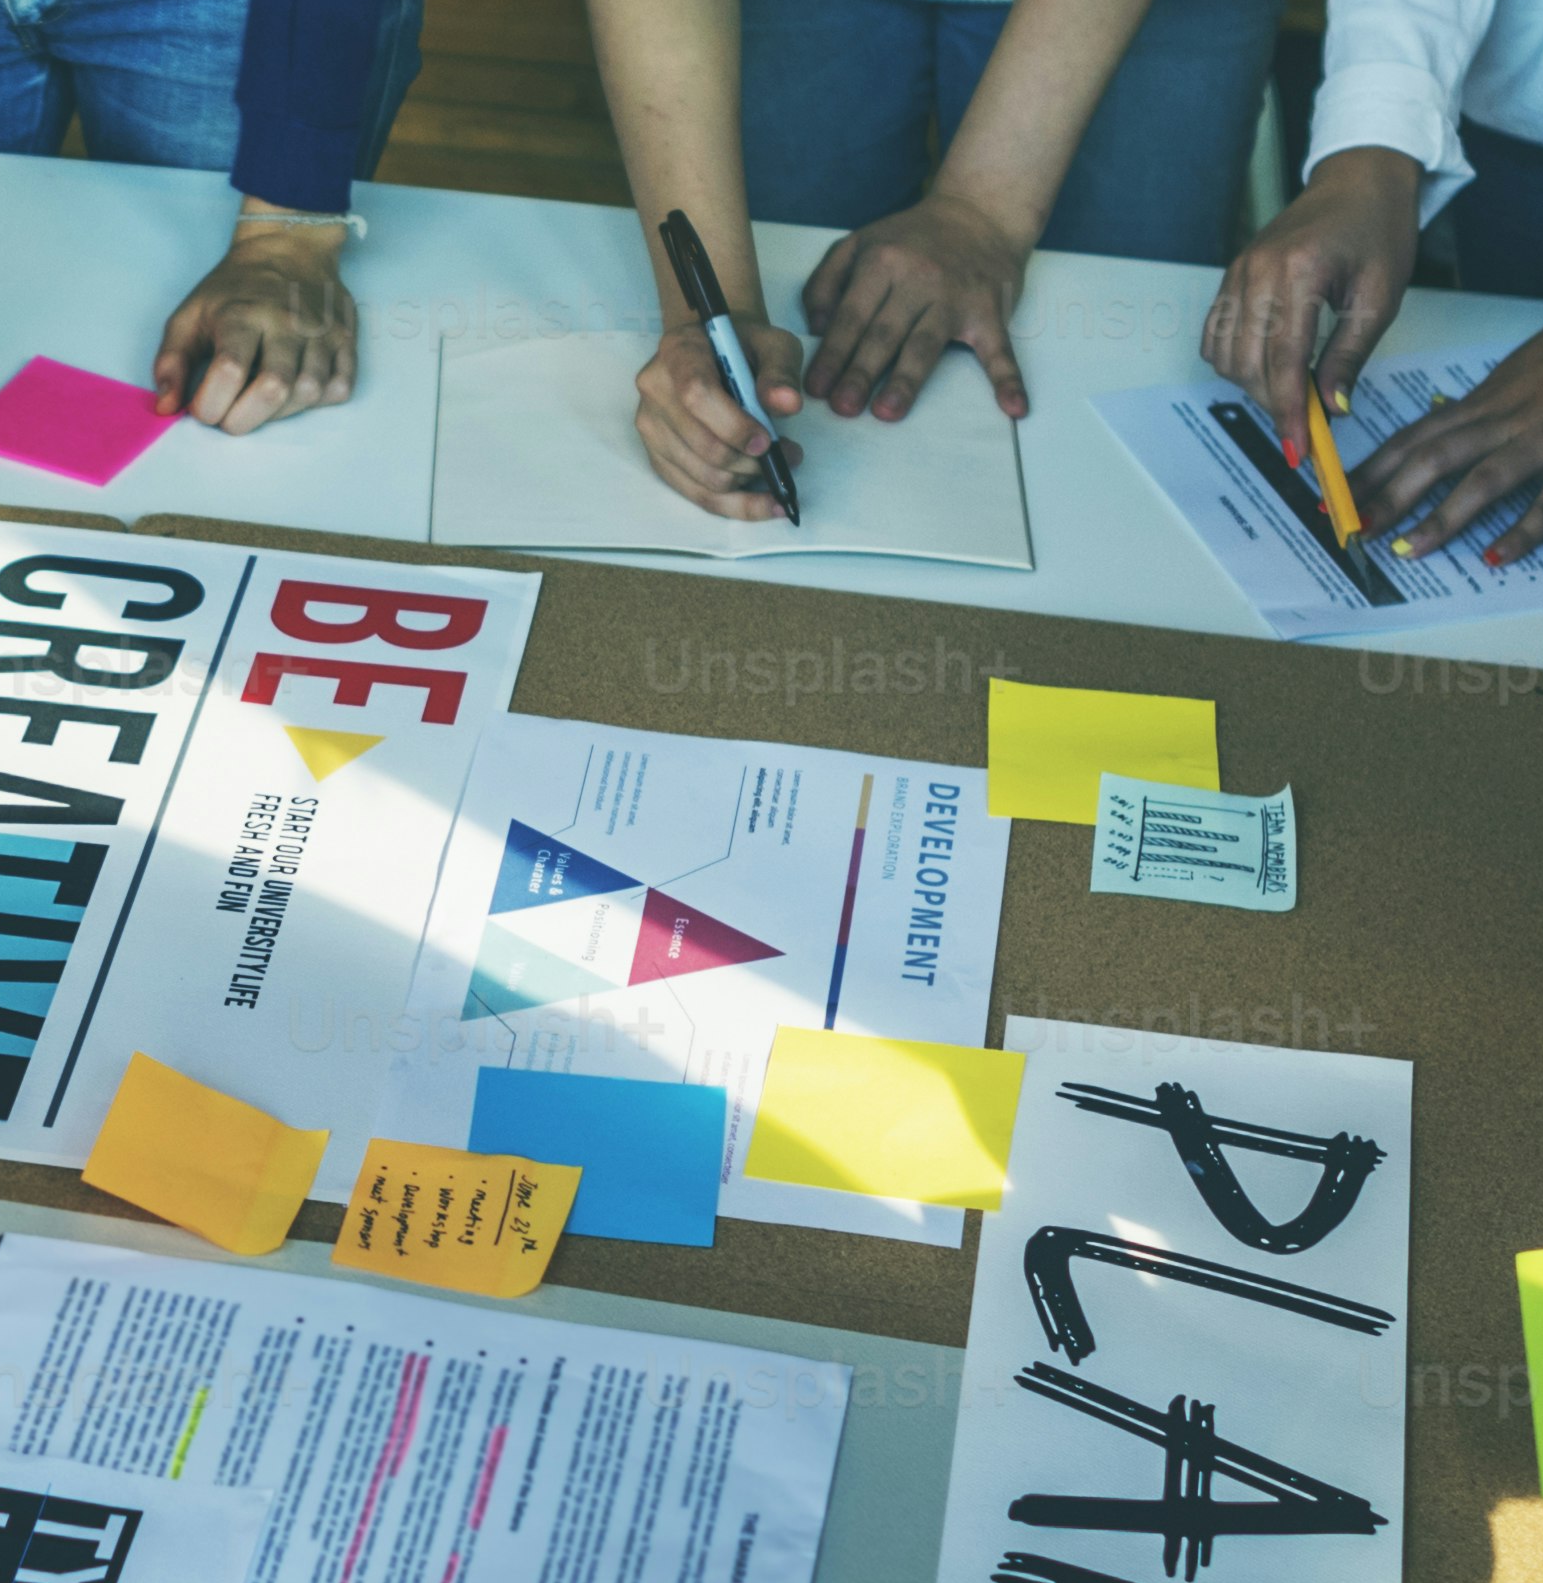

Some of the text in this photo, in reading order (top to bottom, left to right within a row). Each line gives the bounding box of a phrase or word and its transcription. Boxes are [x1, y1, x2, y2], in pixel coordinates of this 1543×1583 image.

[240, 579, 489, 725] BE
[215, 793, 282, 913] FRESH AND FUN
[549, 852, 571, 896] Values &
[881, 777, 909, 880] BRAND EXPLORATION
[1267, 801, 1288, 893] TEAM MEMBERS
[224, 796, 319, 1009] START OUR UNIVERSITY LIFE
[582, 903, 610, 962] Positioning
[901, 782, 961, 986] DEVELOPMENT
[668, 918, 689, 959] Essence
